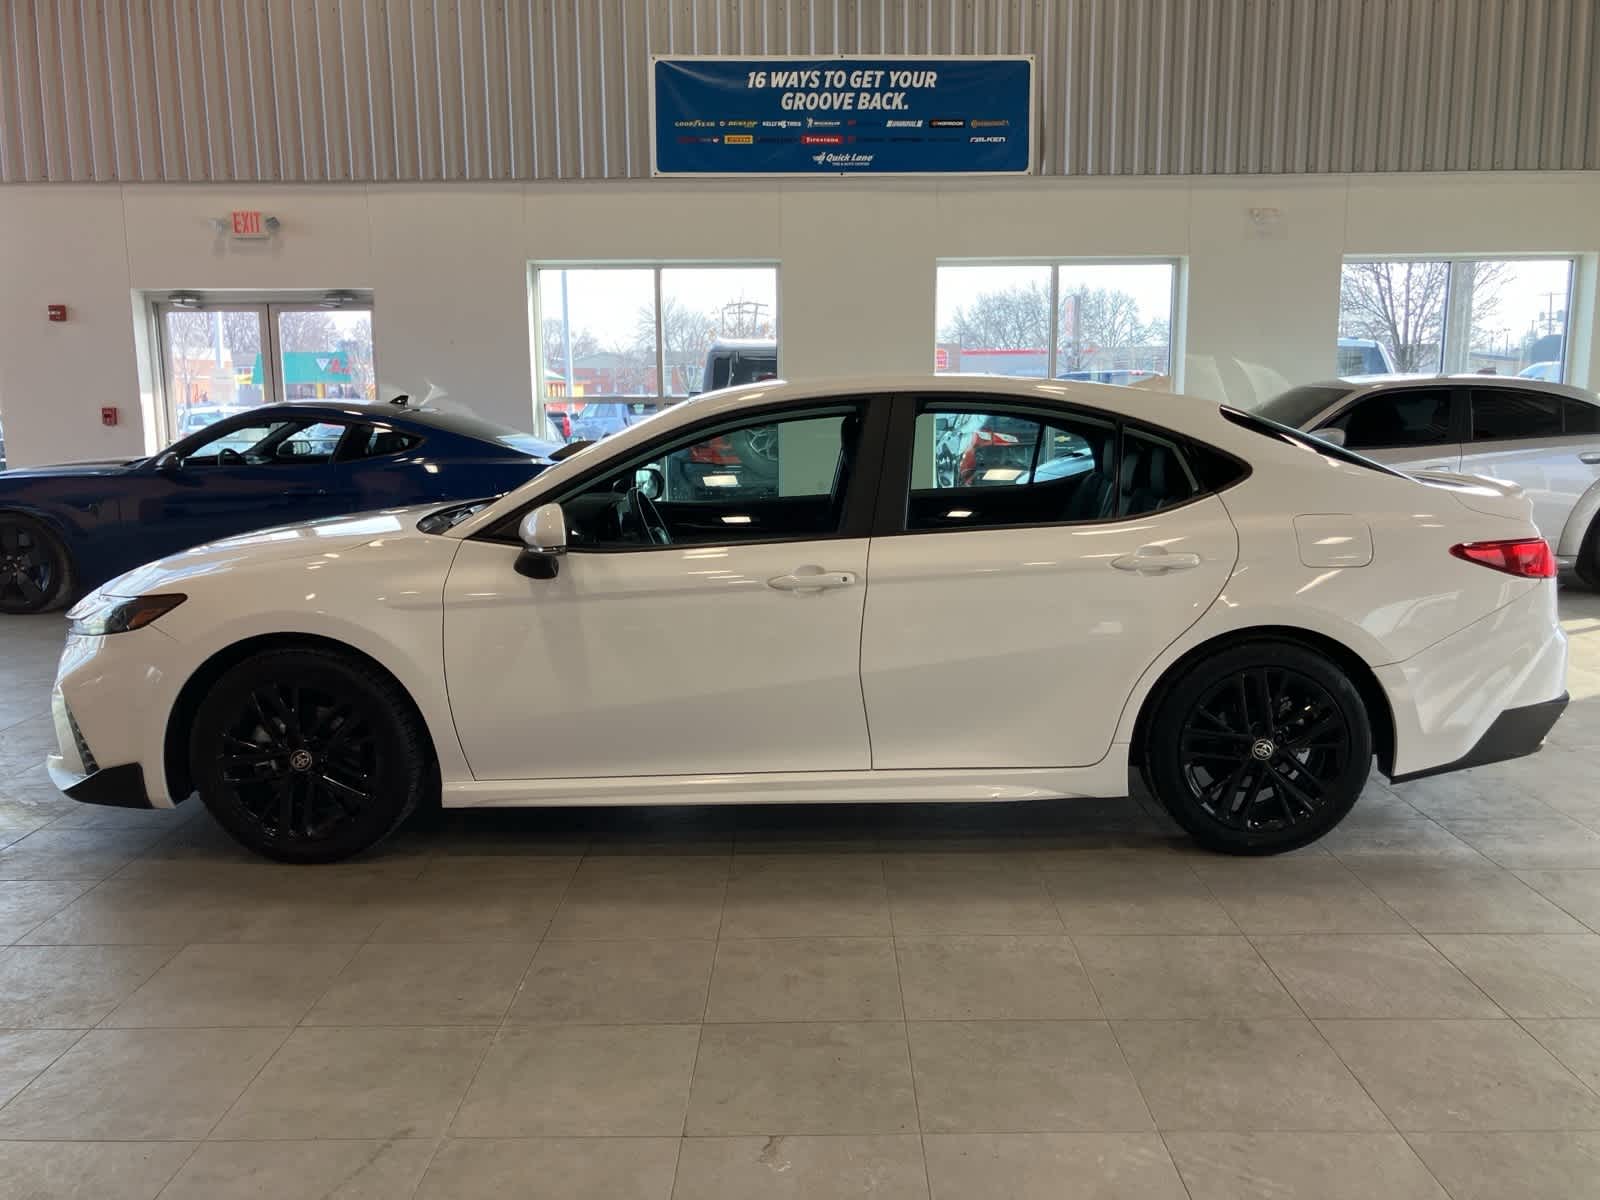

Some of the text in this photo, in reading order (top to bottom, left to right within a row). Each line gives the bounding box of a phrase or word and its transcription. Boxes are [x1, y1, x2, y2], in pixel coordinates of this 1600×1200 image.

[747, 70, 937, 88] 16 WAYS TO GET YOUR
[781, 92, 909, 110] GROOVE BACK.
[826, 153, 873, 162] Quick Lane
[232, 211, 261, 233] EXIT
